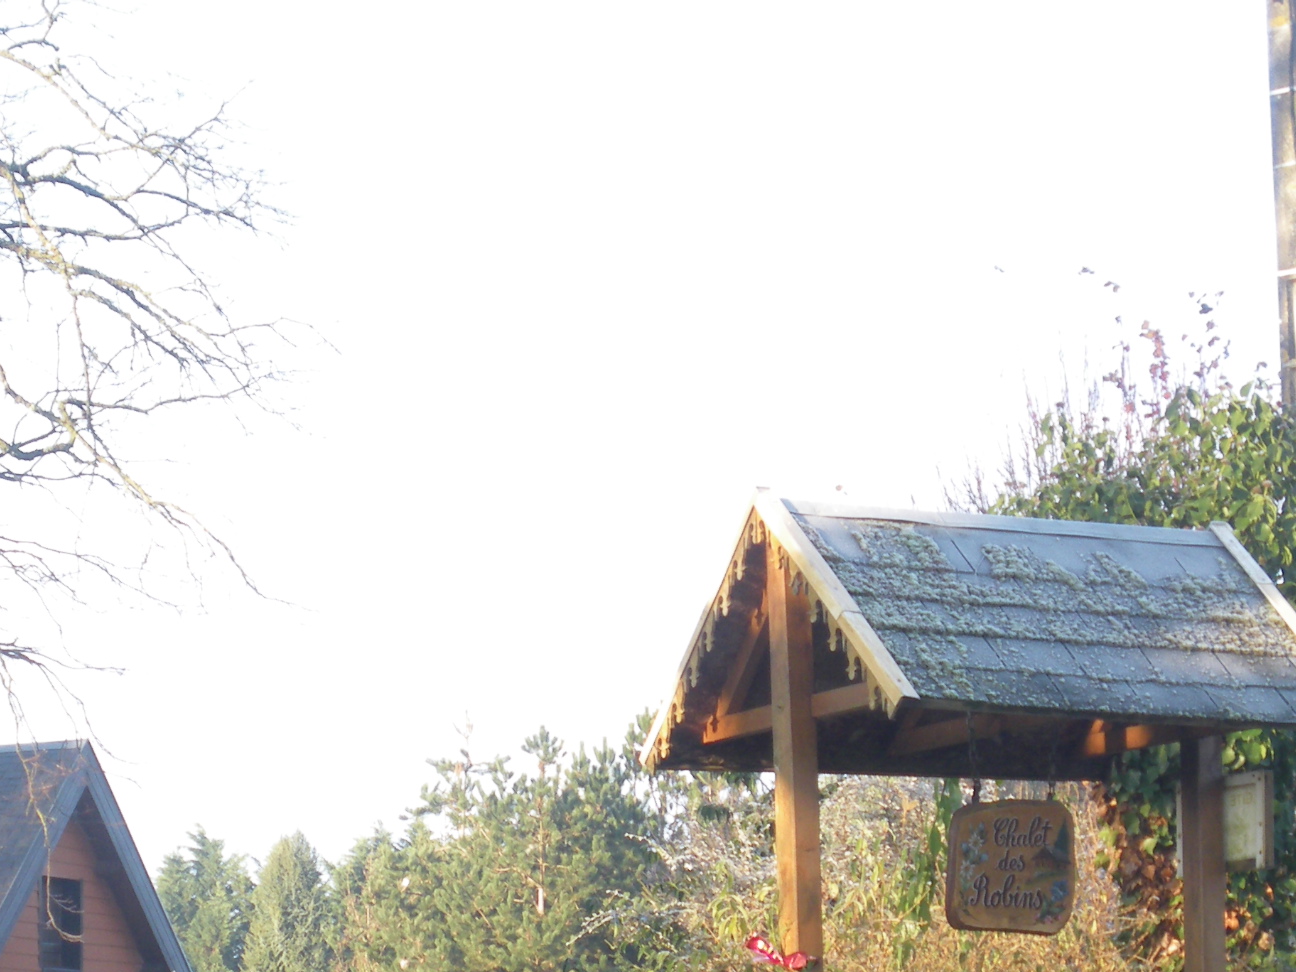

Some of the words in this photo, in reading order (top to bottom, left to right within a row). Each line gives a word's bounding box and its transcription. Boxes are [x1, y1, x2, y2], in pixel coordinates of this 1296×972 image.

[993, 815, 1053, 848] Chalet
[996, 850, 1026, 871] des
[970, 874, 1044, 909] Robins
